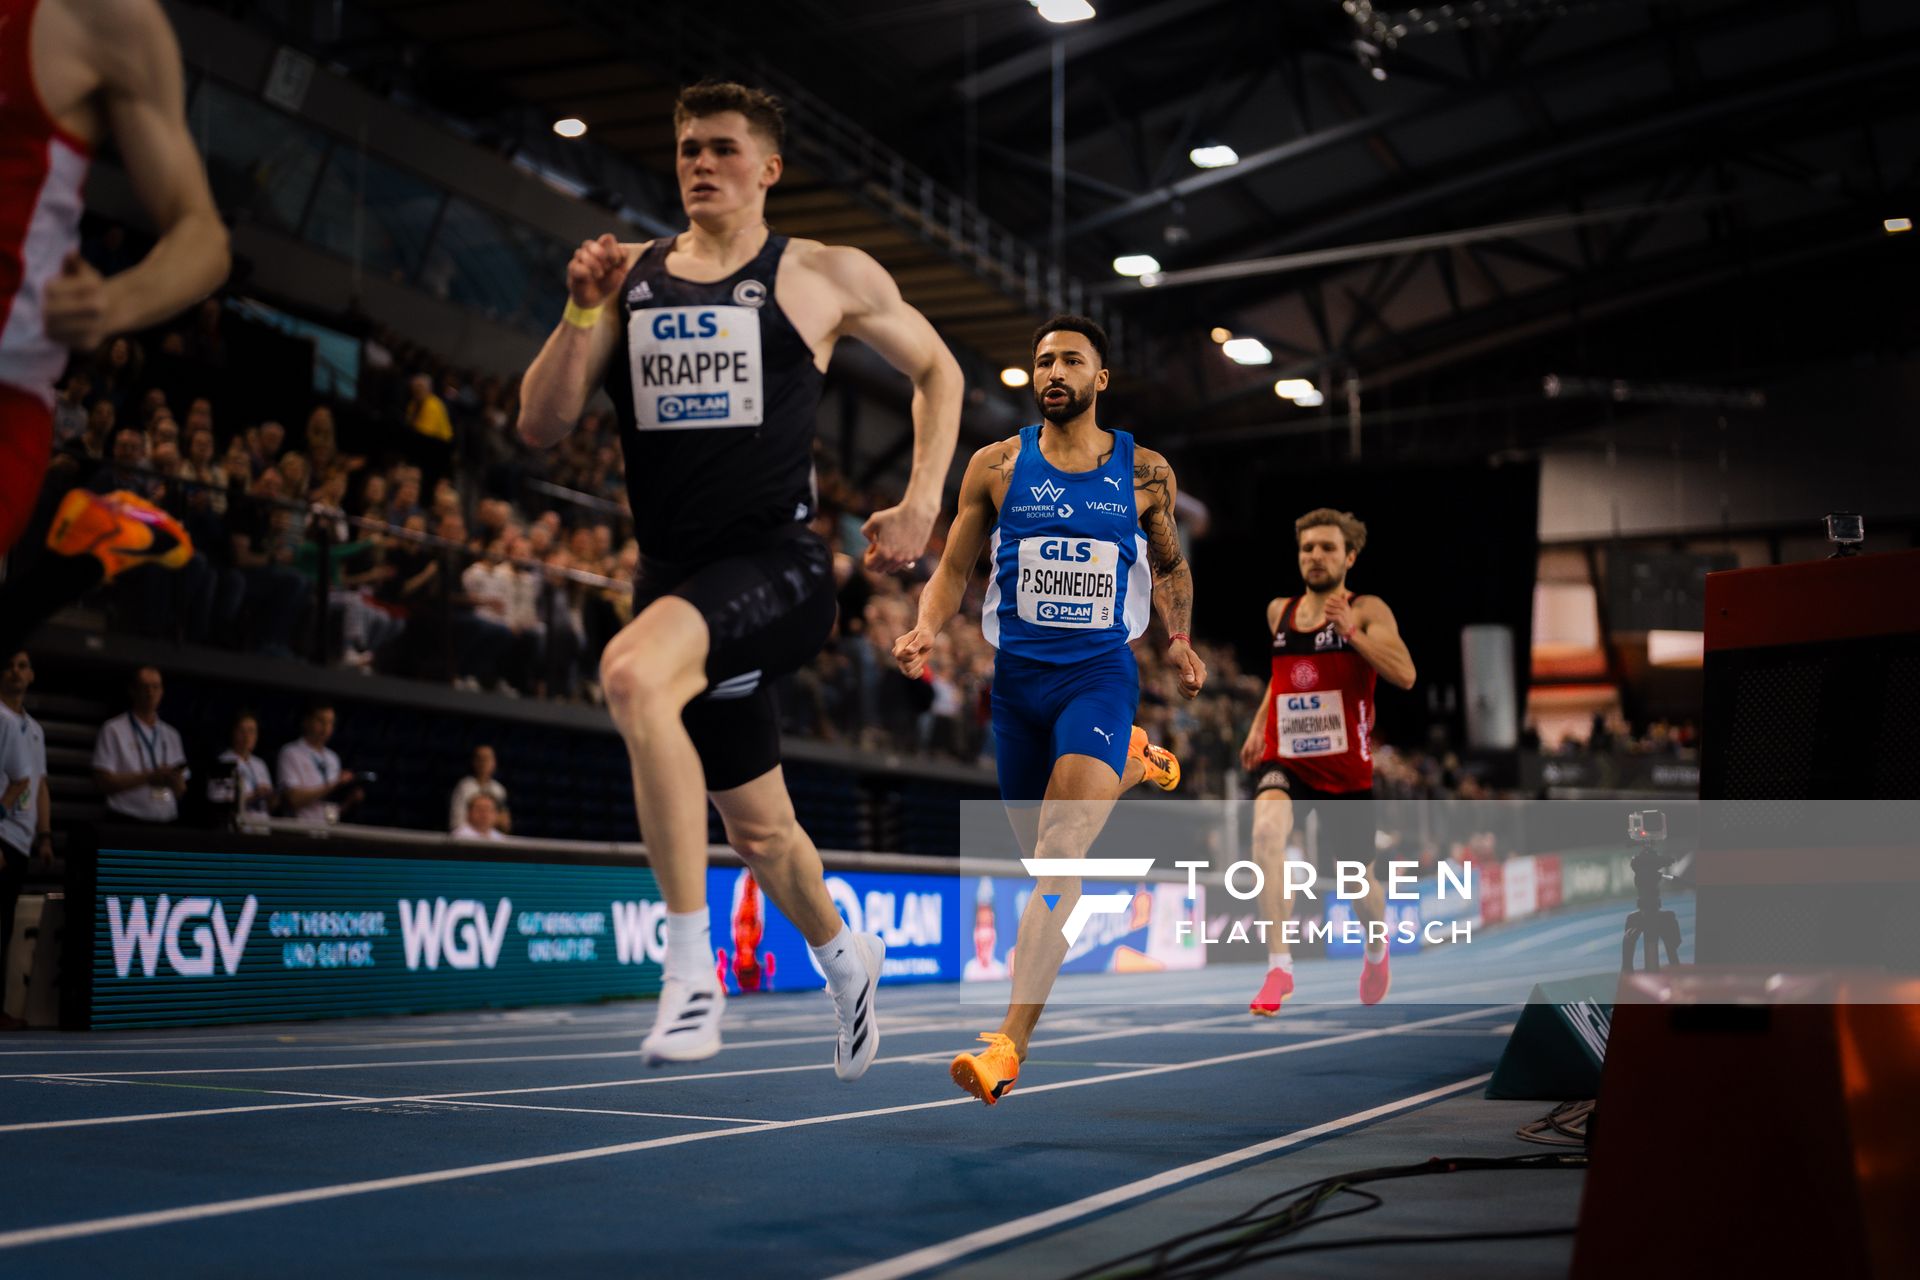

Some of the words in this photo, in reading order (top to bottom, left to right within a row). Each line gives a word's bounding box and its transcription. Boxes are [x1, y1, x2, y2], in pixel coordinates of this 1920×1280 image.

[641, 352, 749, 387] KRAPPE
[685, 396, 727, 411] PLAN
[1085, 501, 1128, 514] VIACTIV
[1021, 568, 1113, 598] P.SCHNEIDER
[1060, 606, 1091, 616] PLAN
[1101, 606, 1109, 621] 470
[106, 894, 258, 978] WGV
[398, 896, 513, 970] WGV
[612, 899, 668, 965] WG
